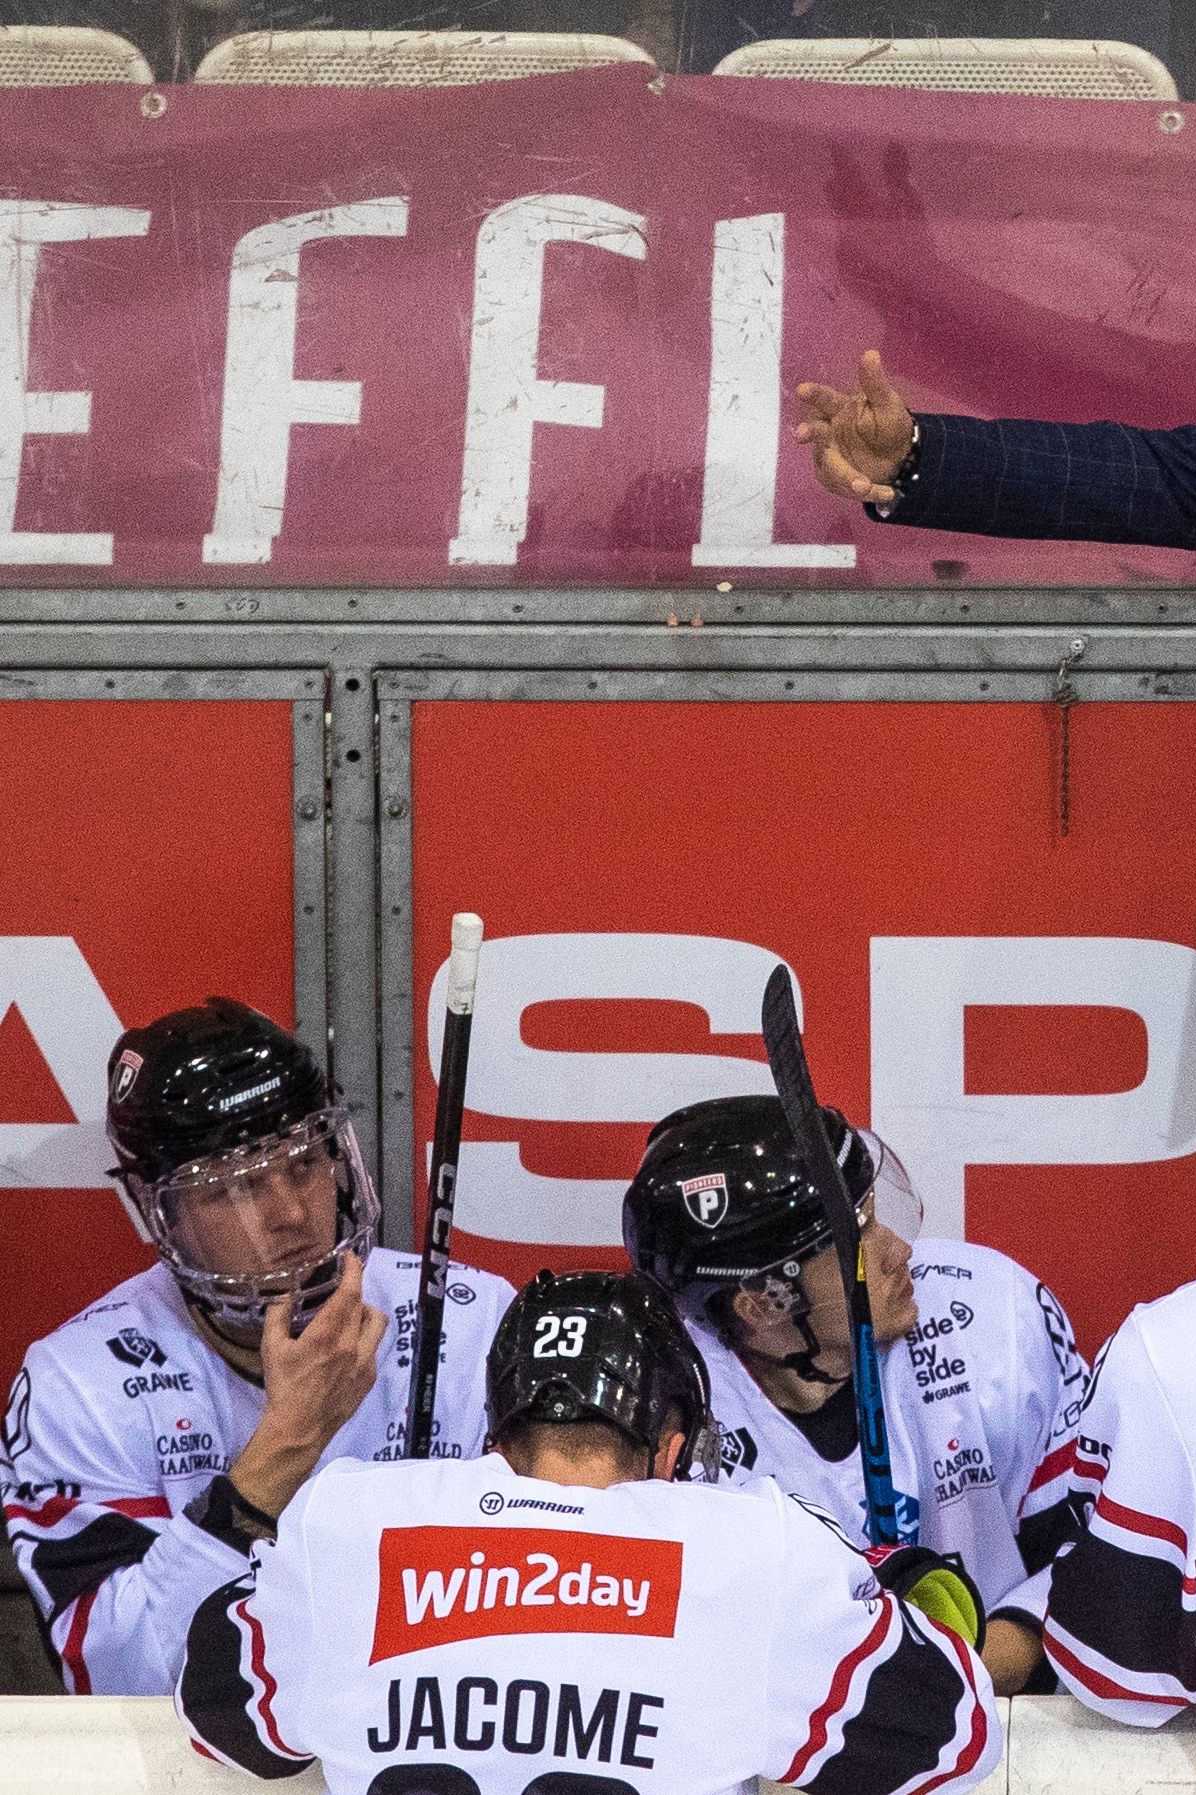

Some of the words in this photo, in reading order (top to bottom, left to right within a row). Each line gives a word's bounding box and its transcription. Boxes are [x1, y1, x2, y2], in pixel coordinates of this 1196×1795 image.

[698, 1189, 719, 1220] P
[911, 1263, 973, 1281] EMER
[534, 1316, 587, 1358] 23
[905, 1316, 954, 1348] side
[909, 1344, 936, 1368] by
[916, 1357, 967, 1388] side
[935, 1381, 971, 1402] GRAWE
[506, 1498, 585, 1515] WARRIOR
[401, 1551, 651, 1627] win2day
[367, 1676, 665, 1770] JACOME
